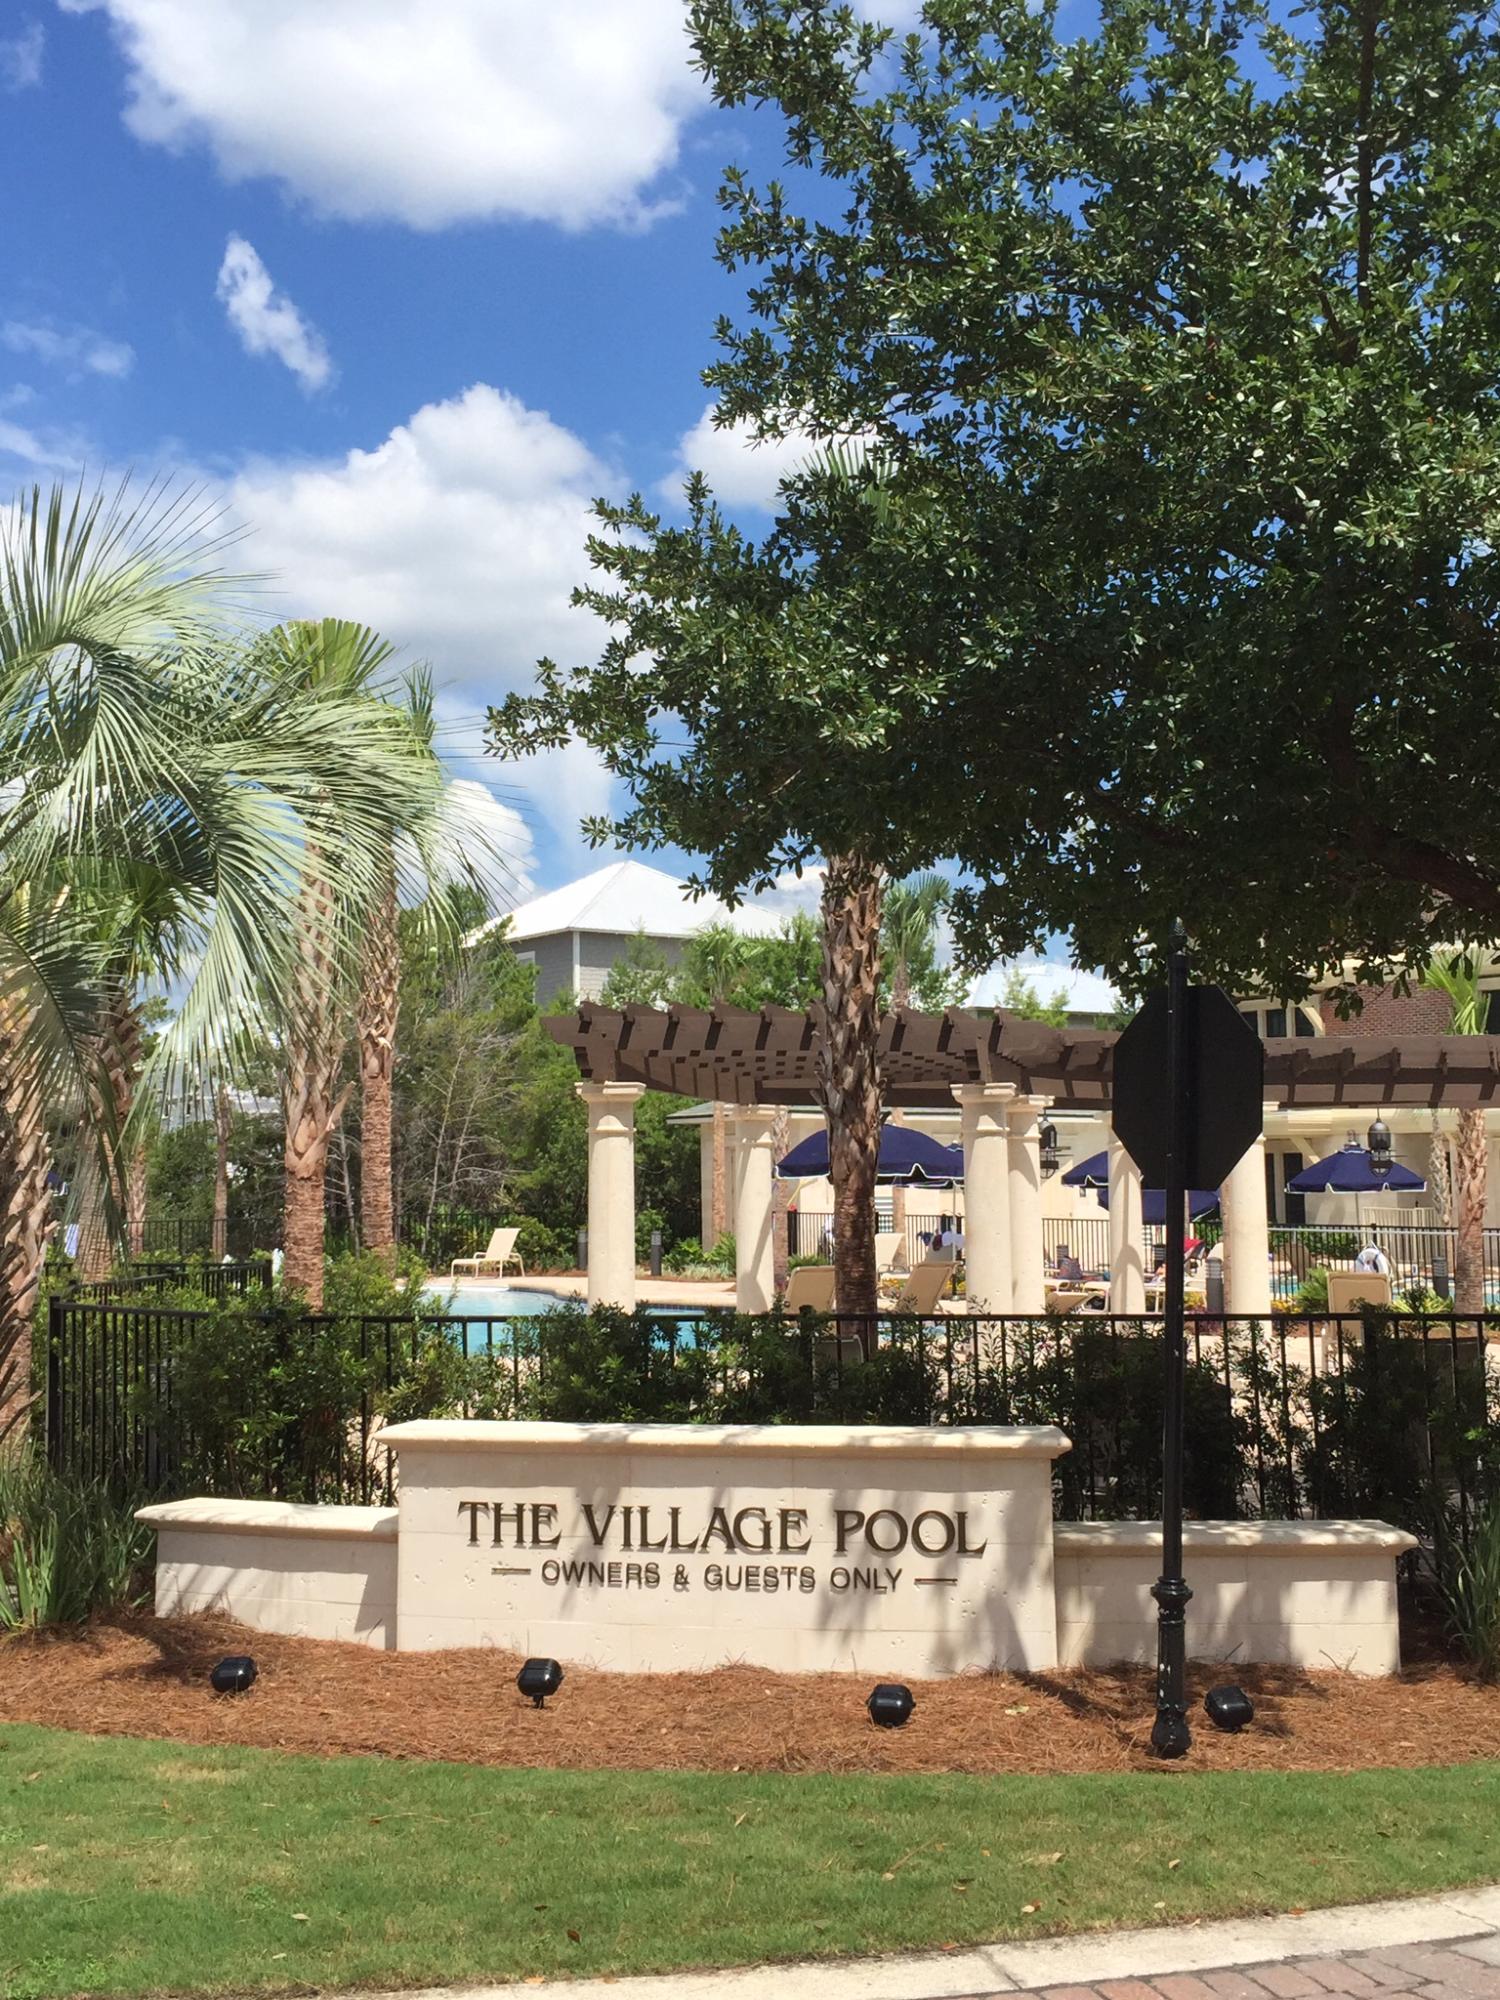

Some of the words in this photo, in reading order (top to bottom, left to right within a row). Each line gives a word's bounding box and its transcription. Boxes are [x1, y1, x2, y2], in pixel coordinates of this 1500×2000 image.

[458, 1501, 562, 1546] THE
[581, 1504, 812, 1553] VILLAGE
[834, 1510, 988, 1555] POOL
[541, 1560, 660, 1587] OWNERS
[674, 1564, 690, 1590] &
[704, 1564, 816, 1591] GUESTS
[830, 1566, 903, 1591] ONLY
